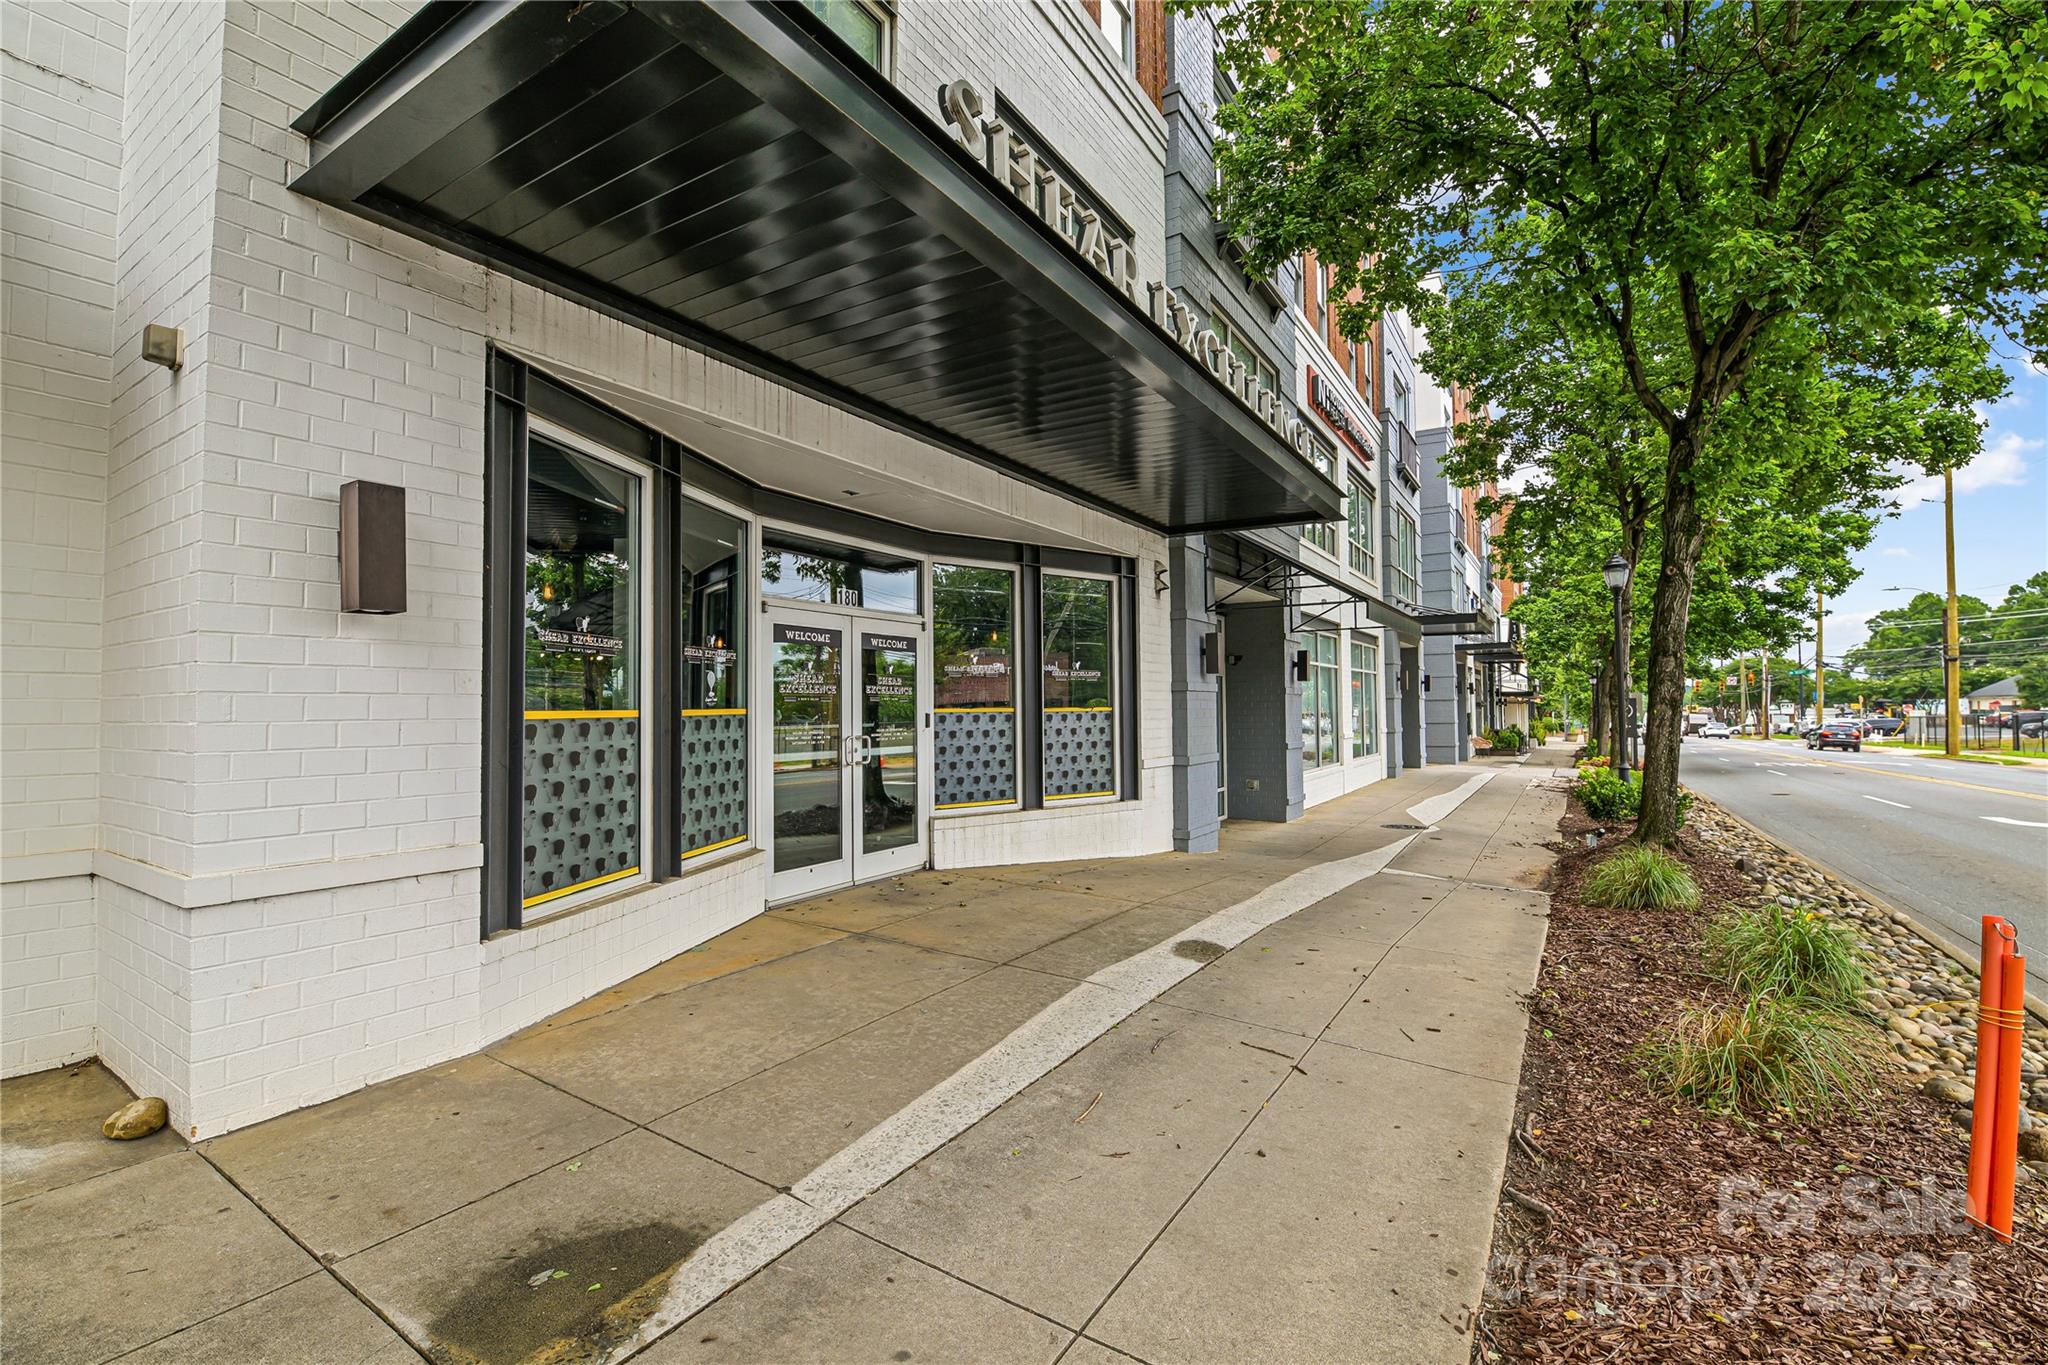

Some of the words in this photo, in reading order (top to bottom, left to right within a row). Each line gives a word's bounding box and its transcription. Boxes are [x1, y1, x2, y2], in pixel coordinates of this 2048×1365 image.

[940, 79, 1141, 310] SHEAR
[838, 590, 857, 607] 180
[538, 629, 569, 643] SHEAR
[572, 634, 623, 648] EXCELLENCE
[785, 630, 831, 643] WELCOME
[870, 638, 907, 649] WELCOME
[793, 673, 824, 685] SHEAR
[877, 677, 902, 686] SHEAR
[779, 683, 837, 695] EXCELLENCE
[865, 685, 913, 695] EXCELLENCE
